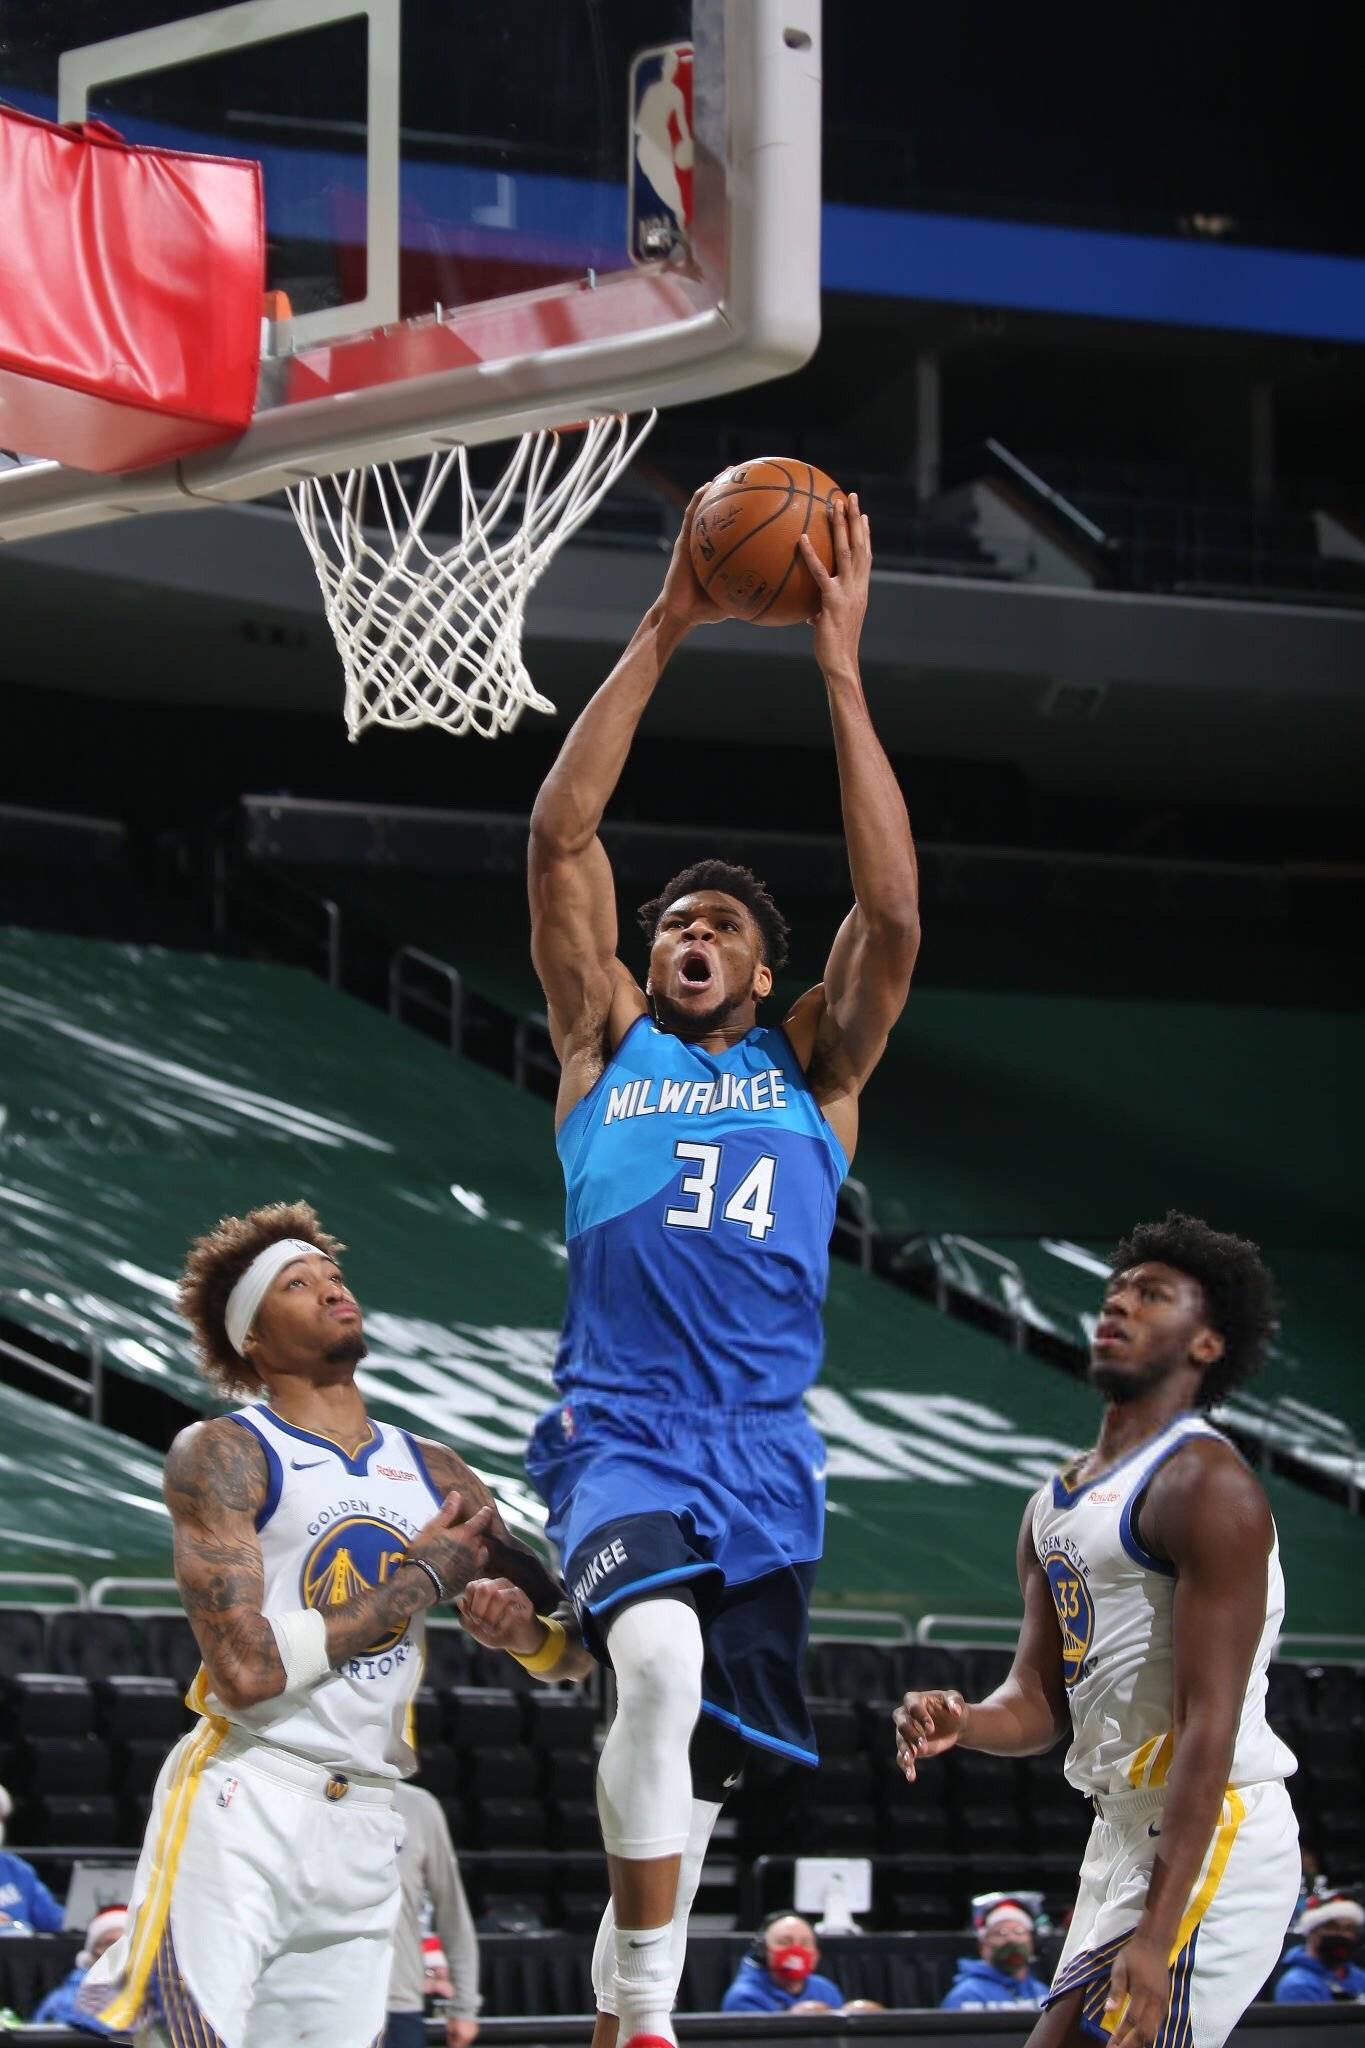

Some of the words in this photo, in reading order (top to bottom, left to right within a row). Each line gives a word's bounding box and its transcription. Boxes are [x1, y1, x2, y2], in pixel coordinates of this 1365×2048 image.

[602, 1068, 787, 1126] MILWAUKEE
[663, 1139, 778, 1242] 34
[307, 1499, 370, 1536] GOLDEN
[378, 1505, 422, 1537] STAT
[1064, 1538, 1091, 1578] STATE
[1056, 1581, 1079, 1618] 33
